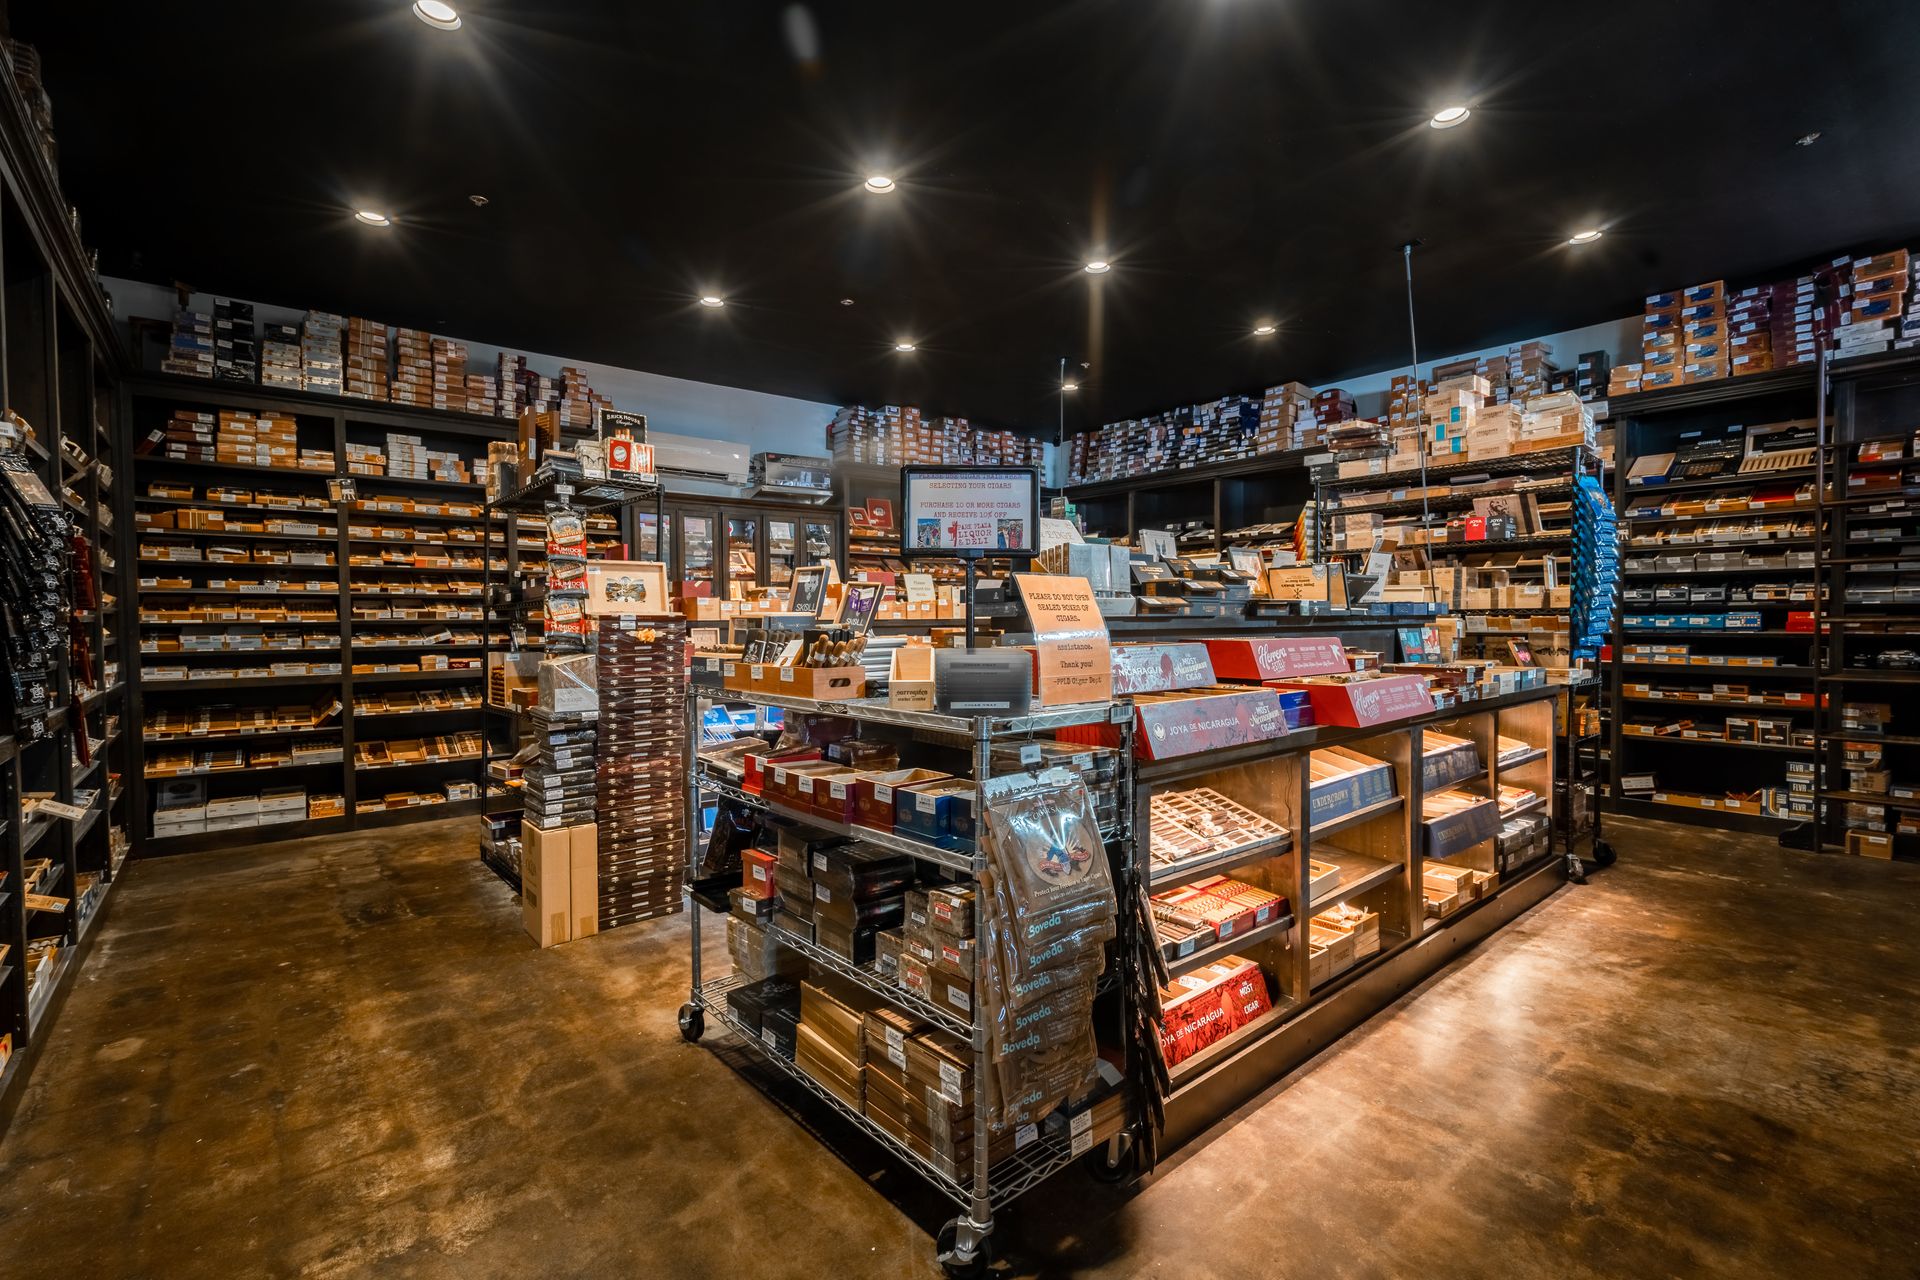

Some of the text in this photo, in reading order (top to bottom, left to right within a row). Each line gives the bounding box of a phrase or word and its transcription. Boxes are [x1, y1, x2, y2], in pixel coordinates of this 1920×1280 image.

[958, 530, 992, 539] LIQUOR
[965, 537, 989, 546] DELI
[1029, 592, 1053, 600] PLEASE
[1038, 603, 1061, 611] SEALED
[1057, 643, 1093, 651] assistance.
[1060, 660, 1093, 669] Thank you!
[1182, 657, 1197, 665] MOST
[1118, 665, 1163, 677] NICARAGUA
[1071, 677, 1088, 686] Cigar
[1185, 673, 1202, 681] CIGAR
[1255, 705, 1270, 714] MOST
[1169, 717, 1240, 736] JOYA DE NICARAGUA
[1260, 724, 1276, 732] CIGAR
[1789, 763, 1804, 772] FLVR
[1792, 783, 1807, 792] FLVR
[1792, 802, 1807, 811] FLVR
[1028, 914, 1062, 939] Boveda
[1029, 943, 1063, 969] Boveda
[1015, 974, 1051, 997] Boveda
[1239, 983, 1254, 997] MOST
[1244, 1000, 1259, 1015] CIGAR
[1015, 1004, 1052, 1031] Boveda
[1161, 1007, 1225, 1048] OYA DE NICARAGUA
[1000, 1032, 1041, 1056] Boveda
[1008, 1089, 1042, 1118] Boeda
